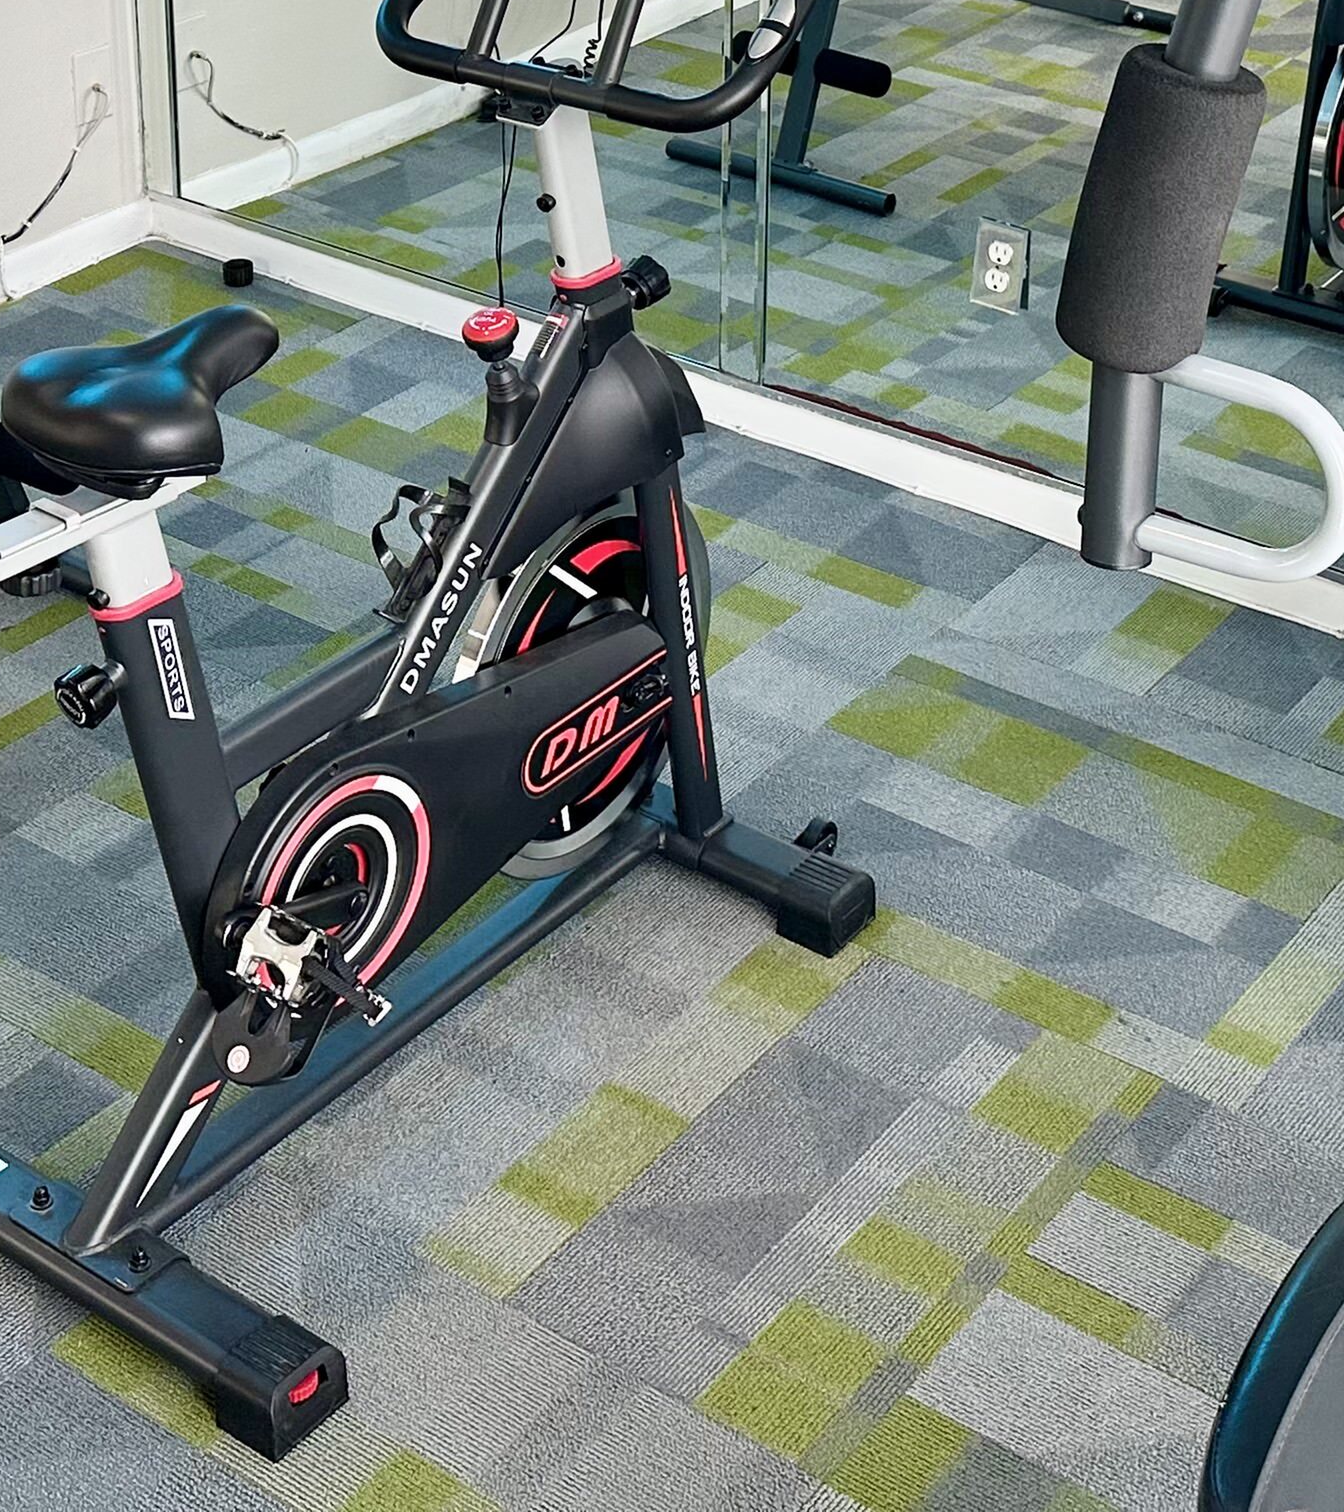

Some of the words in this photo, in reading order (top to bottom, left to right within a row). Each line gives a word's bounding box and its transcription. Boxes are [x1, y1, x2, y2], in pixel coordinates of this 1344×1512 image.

[399, 542, 483, 695] DMASUN
[157, 624, 185, 712] SPORTS
[687, 649, 701, 697] BIKE
